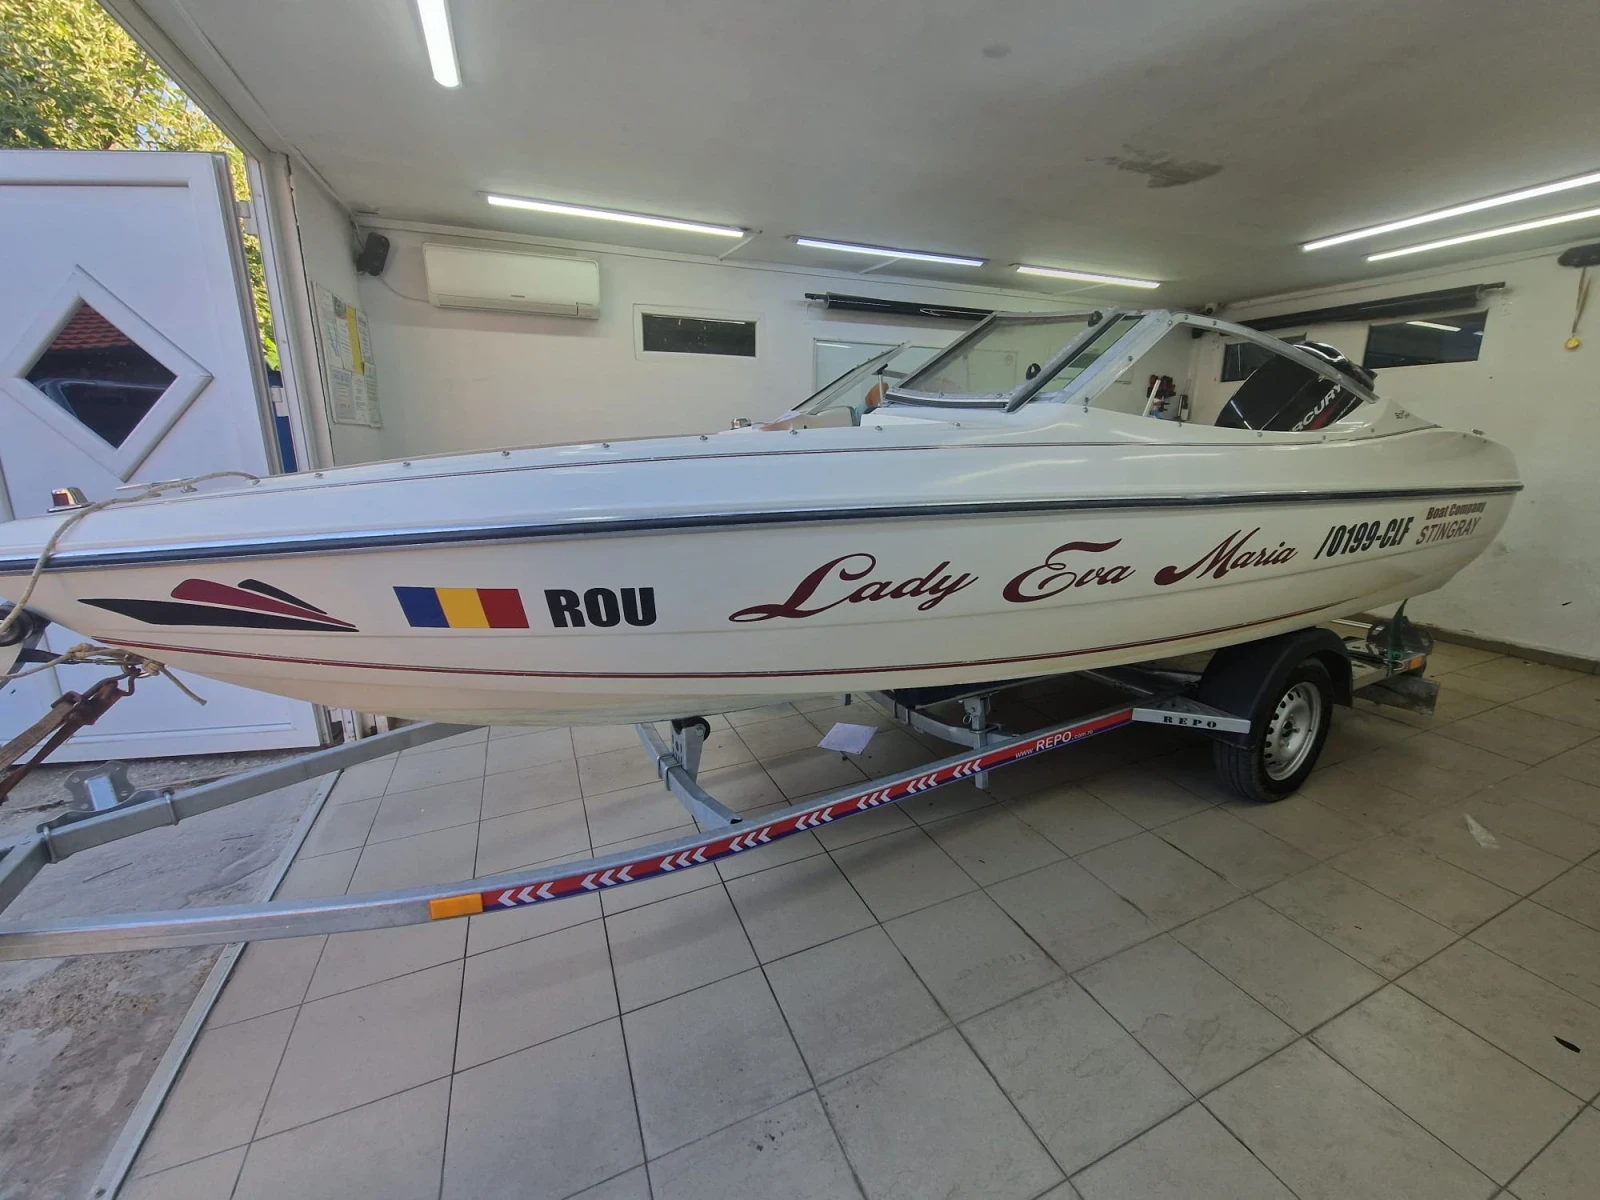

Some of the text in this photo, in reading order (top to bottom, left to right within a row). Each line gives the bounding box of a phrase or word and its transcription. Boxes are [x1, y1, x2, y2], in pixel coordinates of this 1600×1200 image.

[1290, 384, 1341, 432] RCURY
[1415, 516, 1482, 546] STINGRAY
[1425, 501, 1487, 521] Boat Company
[1313, 516, 1415, 560] /0199-CLF
[728, 527, 1298, 623] Lady Eva Maria
[543, 586, 657, 628] ROU
[1163, 715, 1217, 728] REPO
